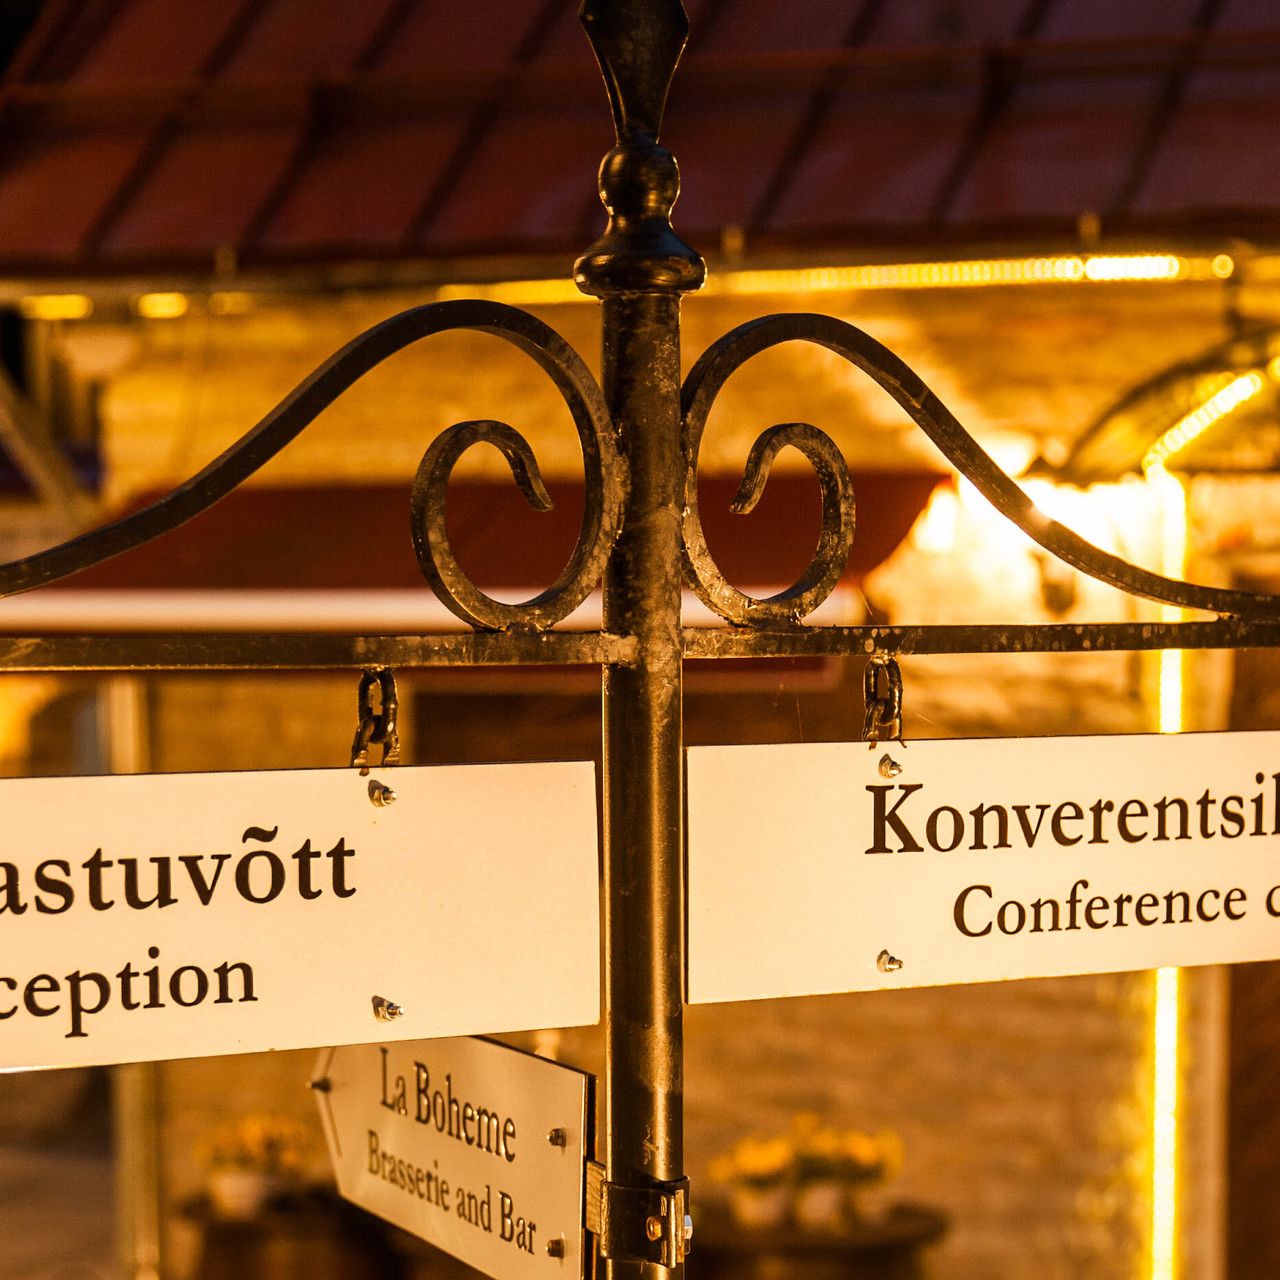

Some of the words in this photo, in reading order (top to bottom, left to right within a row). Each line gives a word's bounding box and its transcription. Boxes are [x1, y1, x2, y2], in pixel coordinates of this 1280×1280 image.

[953, 879, 1247, 938] Conference
[380, 1047, 409, 1117] La
[414, 1061, 517, 1163] Boheme
[367, 1129, 451, 1213] Brasserie
[455, 1185, 493, 1234] and
[498, 1190, 537, 1256] Bar
